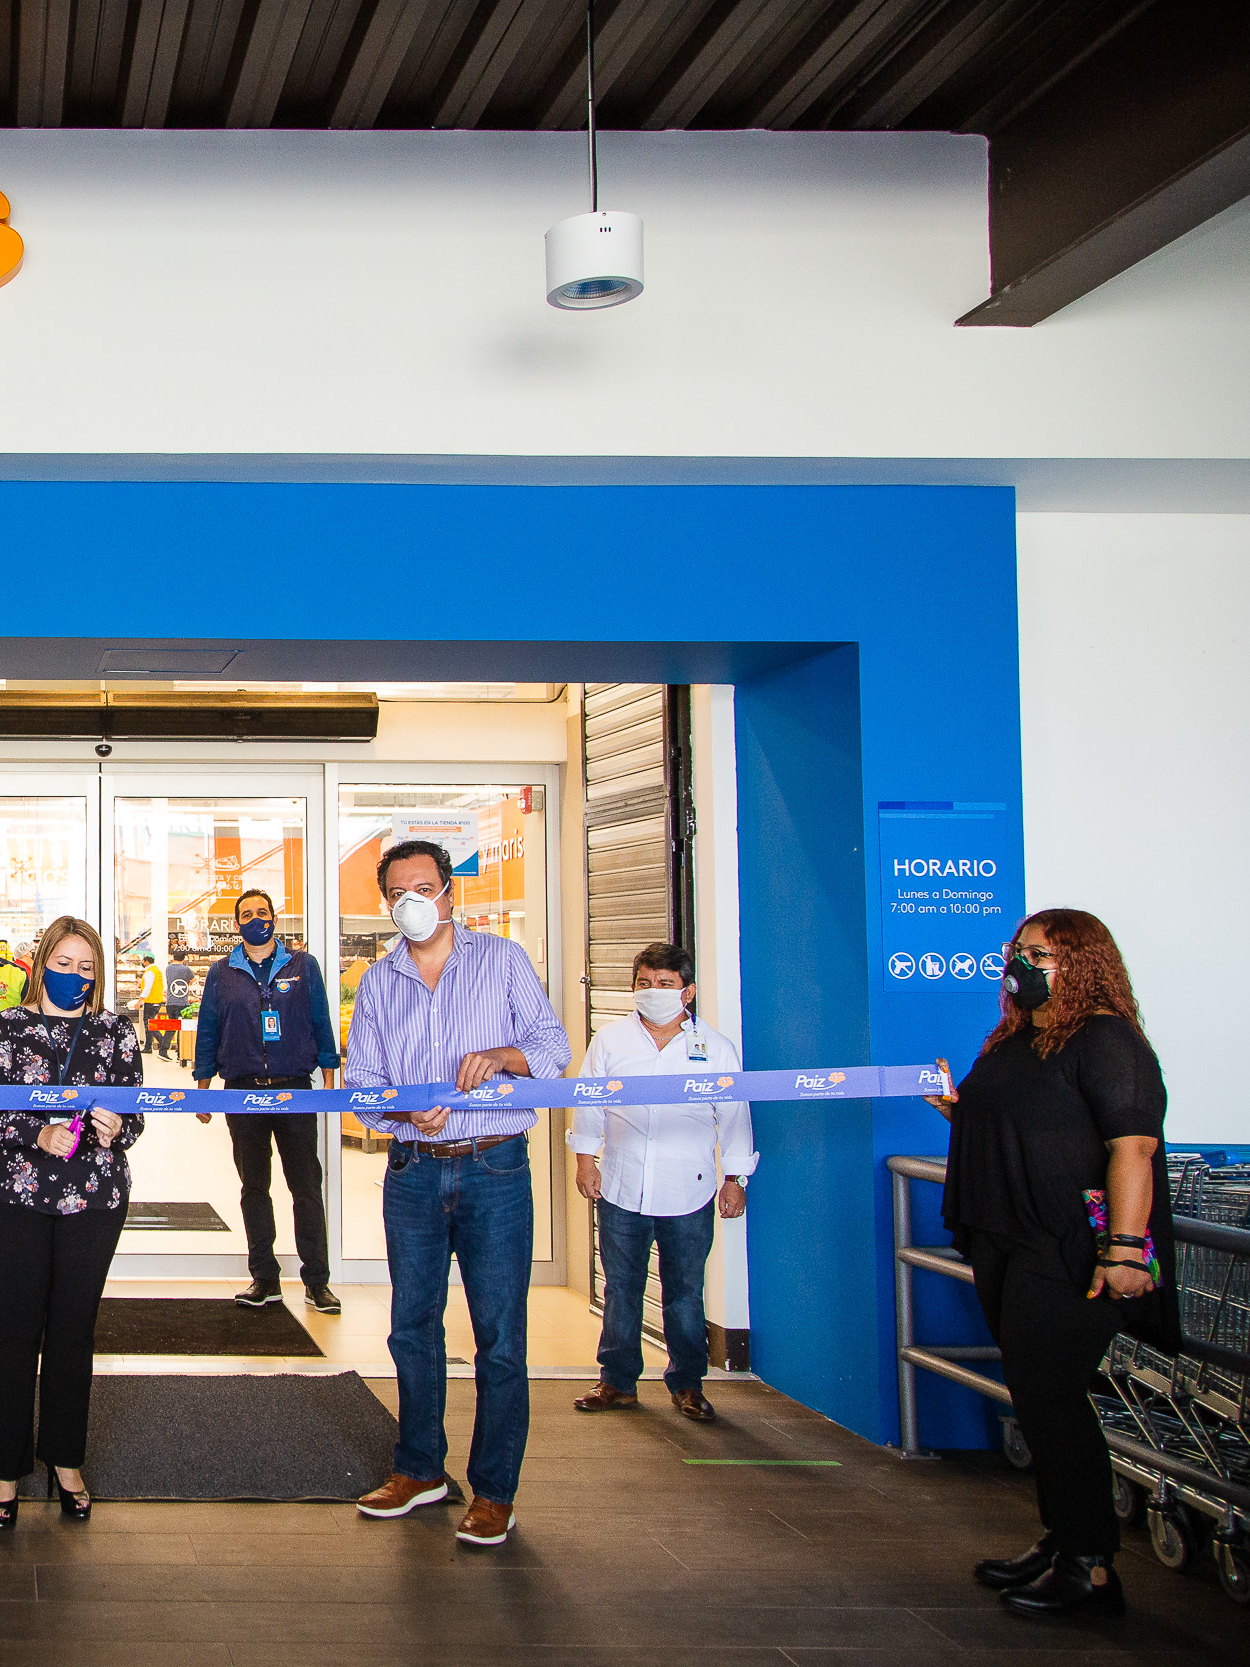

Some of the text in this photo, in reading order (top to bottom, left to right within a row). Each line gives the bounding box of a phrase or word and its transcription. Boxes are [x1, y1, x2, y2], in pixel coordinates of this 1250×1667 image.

[491, 828, 524, 863] maris
[893, 858, 997, 877] HORARIO
[897, 888, 994, 903] Lunes a Domingo
[890, 903, 1002, 917] 7:00 am a 10:00 pm
[177, 920, 236, 932] HORARI
[795, 1074, 826, 1088] Paiz
[918, 1070, 942, 1083] Pai
[573, 1082, 604, 1096] Paiz
[683, 1078, 714, 1092] Paiz
[29, 1089, 59, 1102] Paiz
[136, 1091, 167, 1104] Paiz
[349, 1090, 379, 1103] Paiz
[465, 1086, 496, 1099] Paiz
[243, 1094, 273, 1105] Paiz
